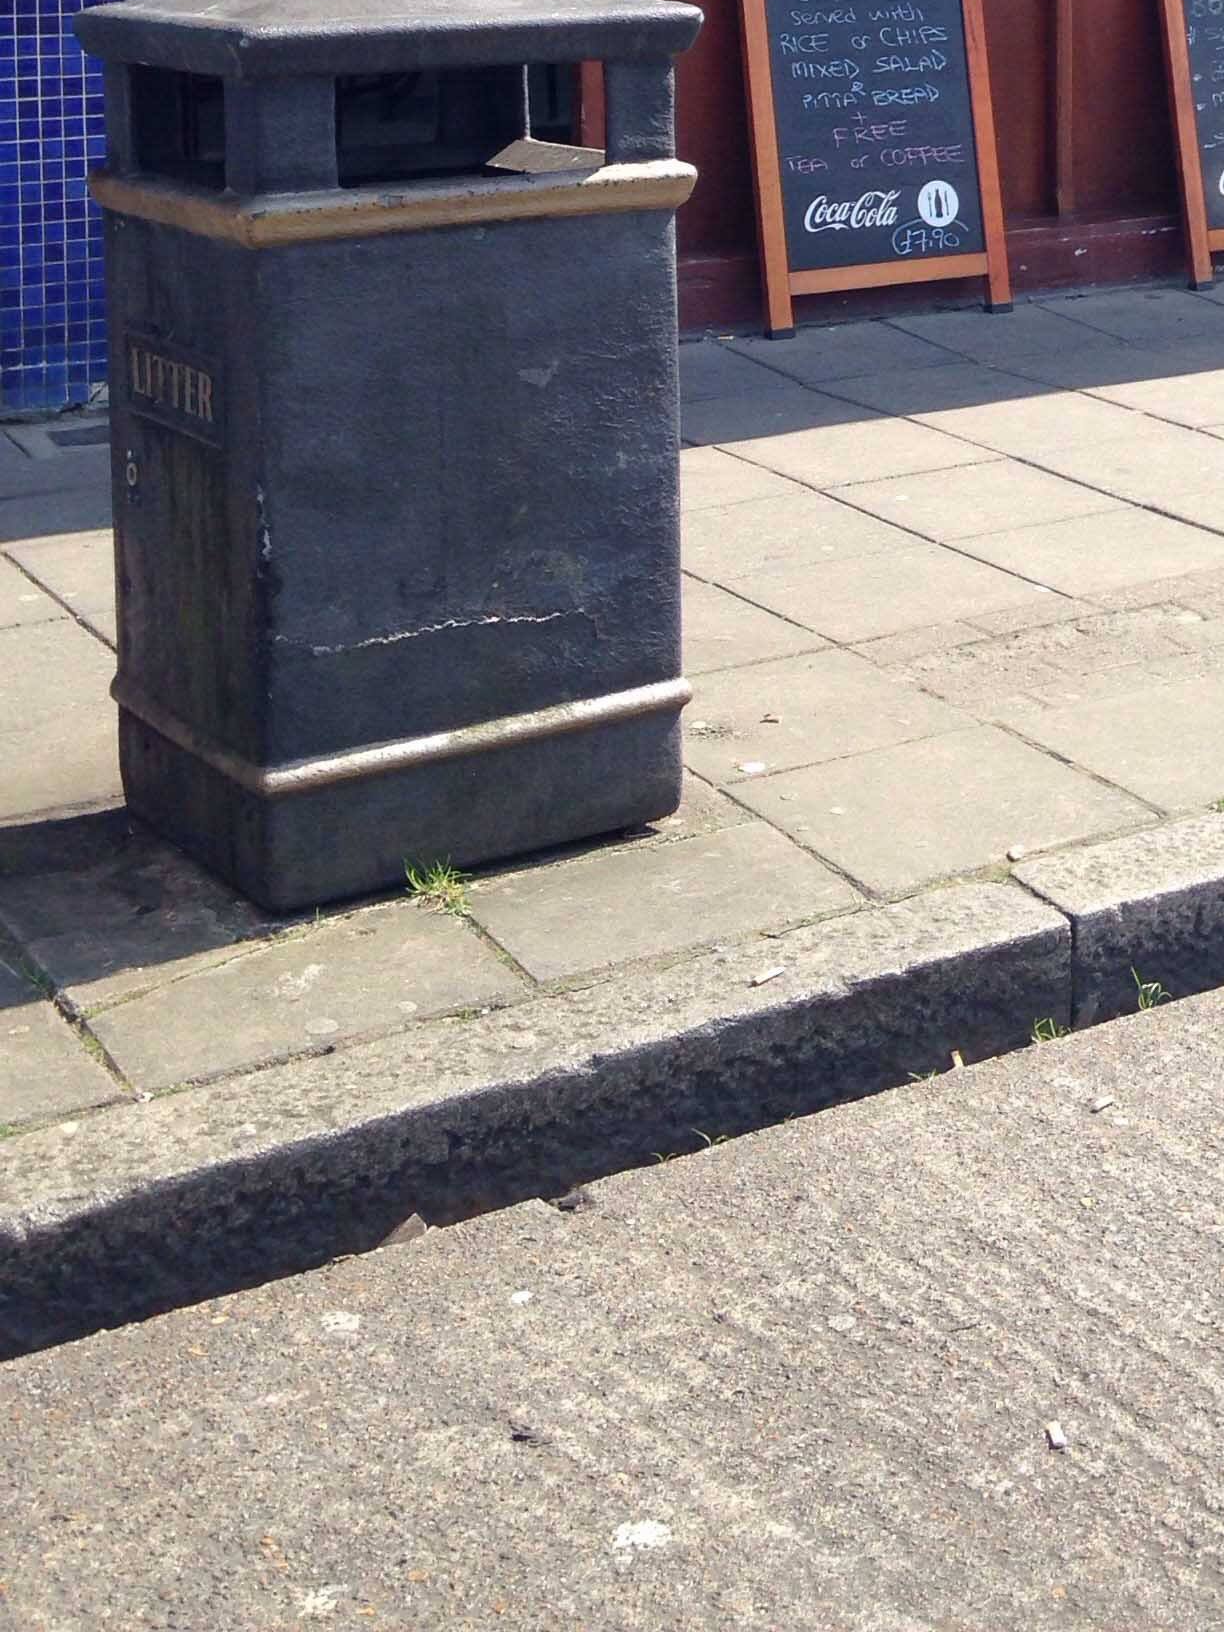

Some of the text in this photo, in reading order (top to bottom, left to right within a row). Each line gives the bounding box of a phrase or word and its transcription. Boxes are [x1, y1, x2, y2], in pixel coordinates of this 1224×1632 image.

[779, 32, 831, 56] RICE
[879, 25, 949, 48] CHIPS
[791, 49, 947, 80] MIXED SALAD
[872, 83, 940, 107] BREAD
[832, 119, 909, 149] FREE
[785, 155, 829, 174] TEA
[880, 143, 966, 167] COFFEE
[804, 190, 902, 233] Coca-Cola
[130, 344, 215, 423] LITTER
